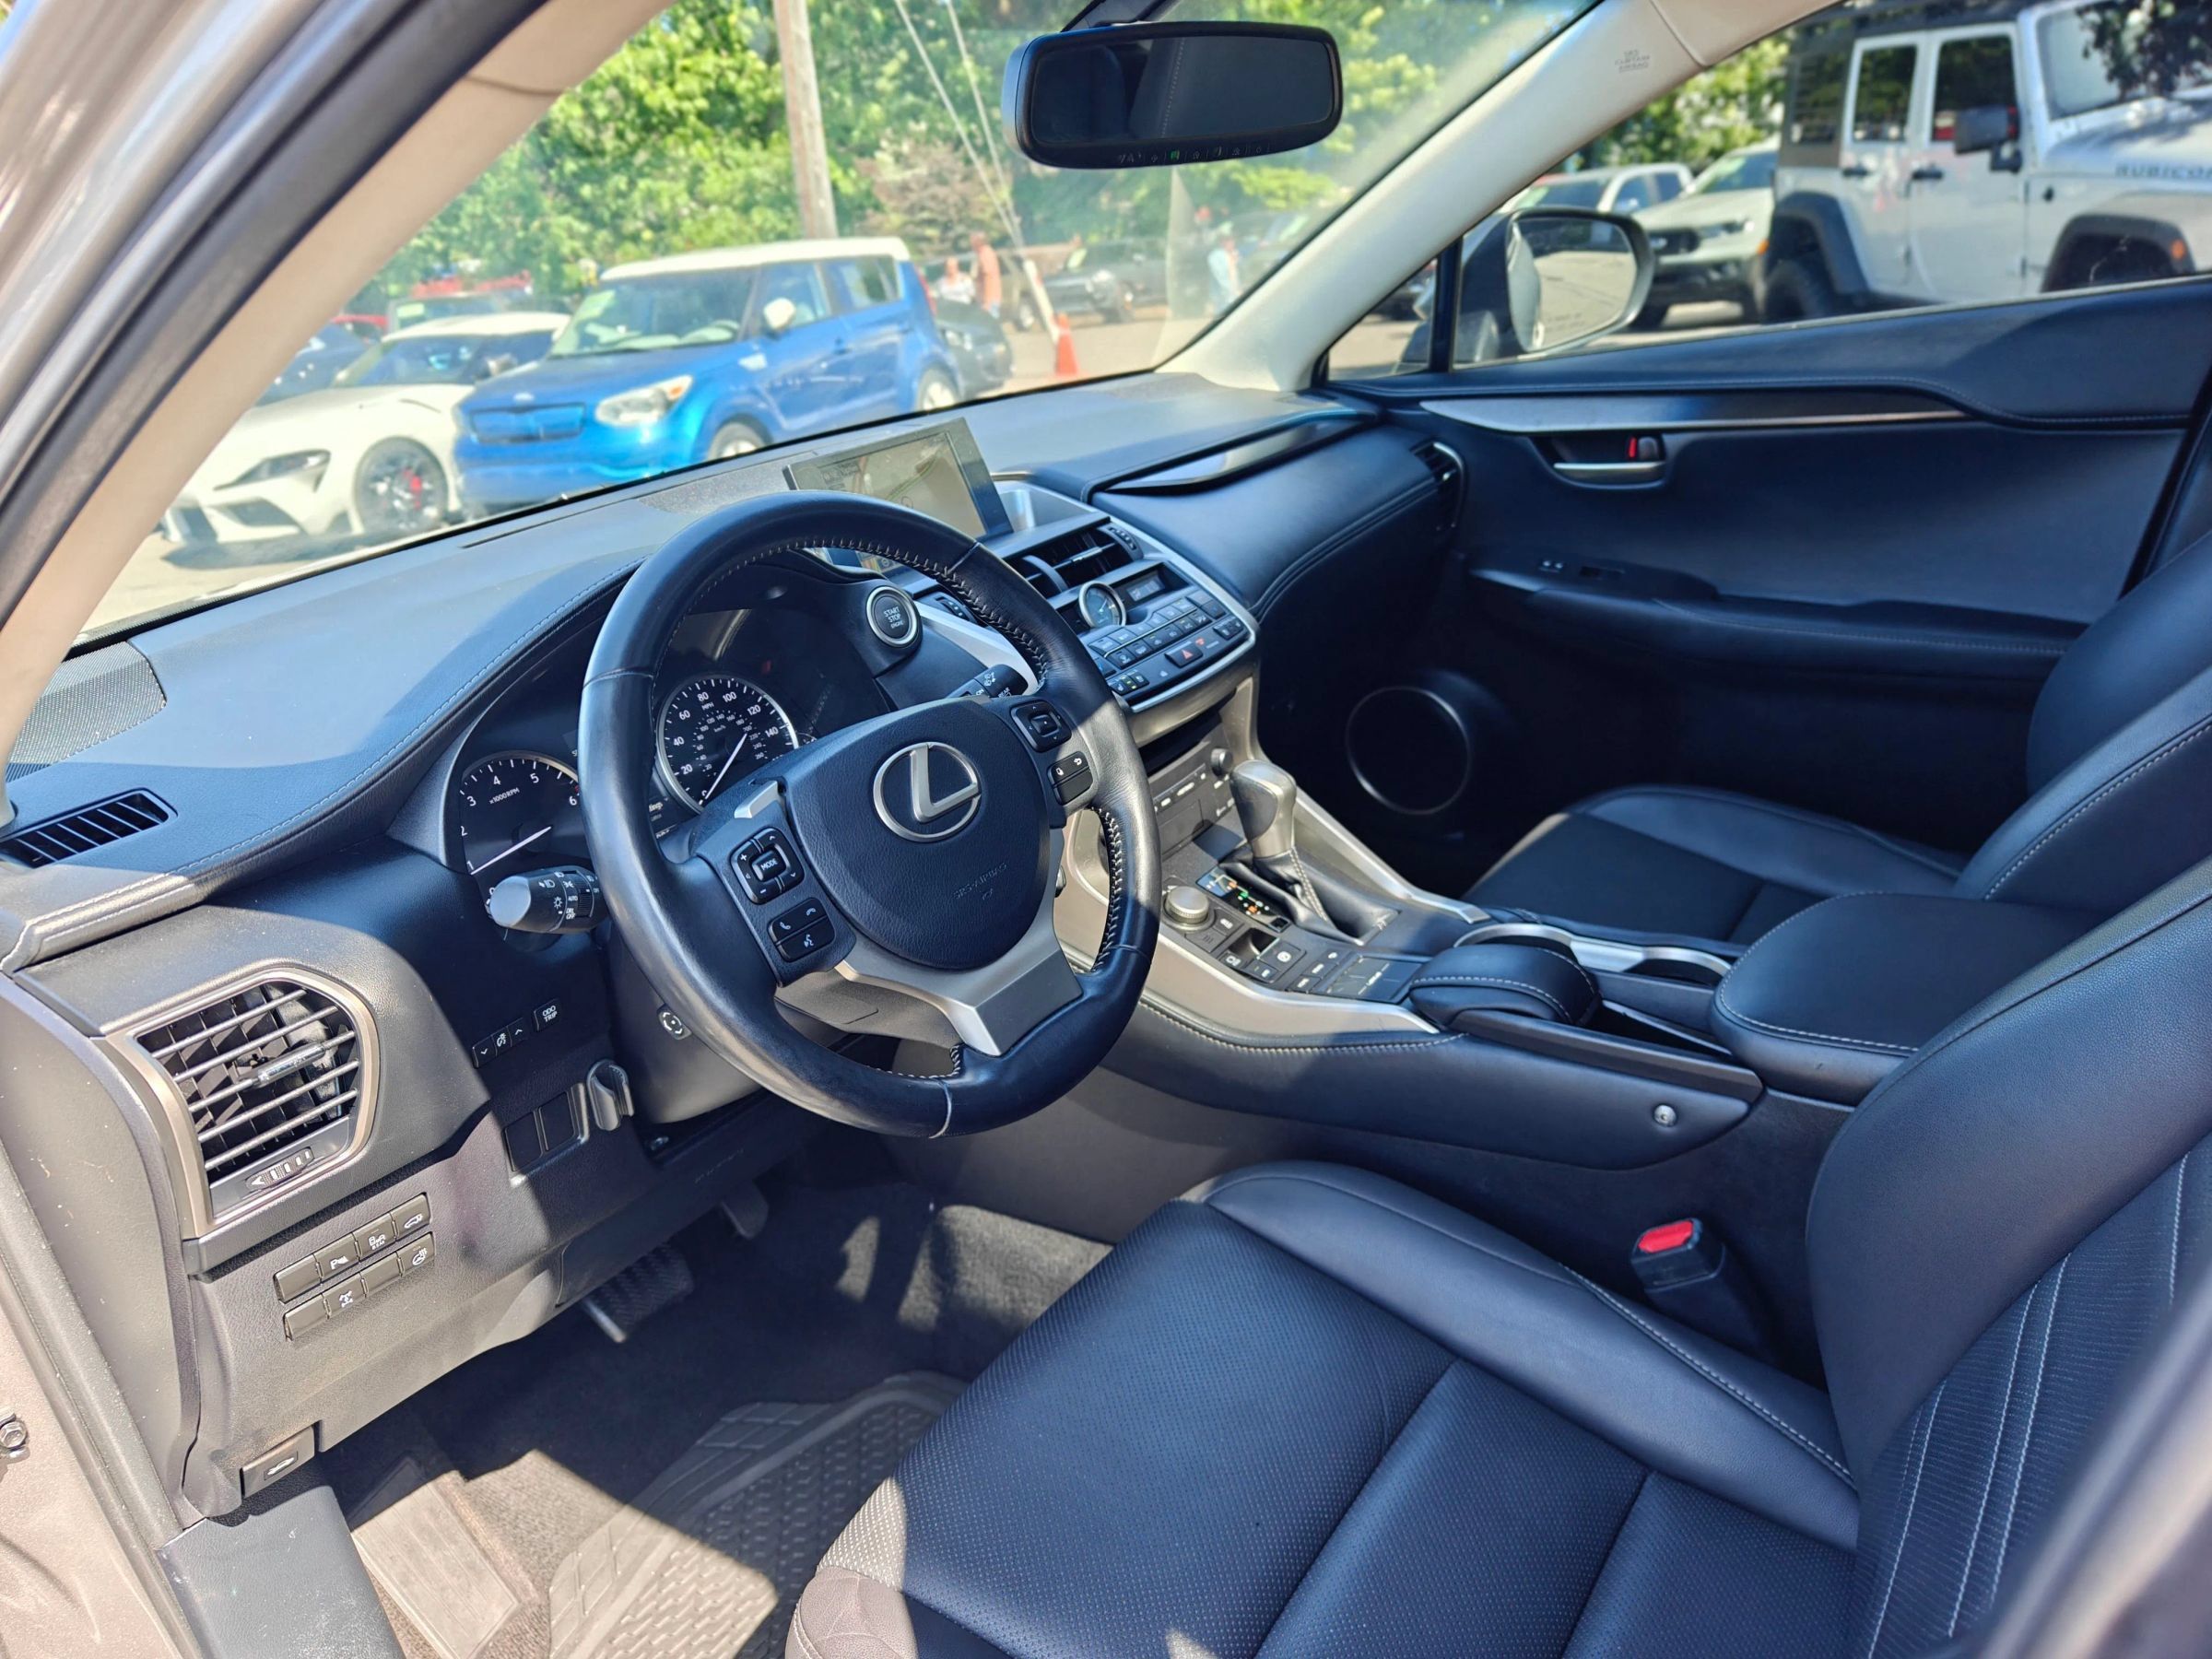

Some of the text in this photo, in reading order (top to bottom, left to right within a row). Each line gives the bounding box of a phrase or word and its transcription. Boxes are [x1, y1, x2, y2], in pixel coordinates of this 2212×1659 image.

[883, 606, 900, 618] START
[888, 613, 901, 623] STOP
[698, 691, 710, 701] 80
[723, 691, 736, 702] 100
[701, 702, 714, 711] MPH
[747, 704, 761, 715] 120
[679, 710, 690, 720] 60
[765, 726, 779, 737] 140
[673, 736, 684, 747] 40
[680, 764, 692, 775] 20
[493, 775, 501, 785] 4
[530, 772, 539, 783] 5
[466, 795, 477, 806] 3
[569, 795, 578, 806] 6
[460, 825, 468, 837] 2
[466, 860, 475, 871] 1
[760, 857, 778, 871] MODE
[542, 1005, 557, 1017] ODO
[544, 1010, 558, 1022] TRIP
